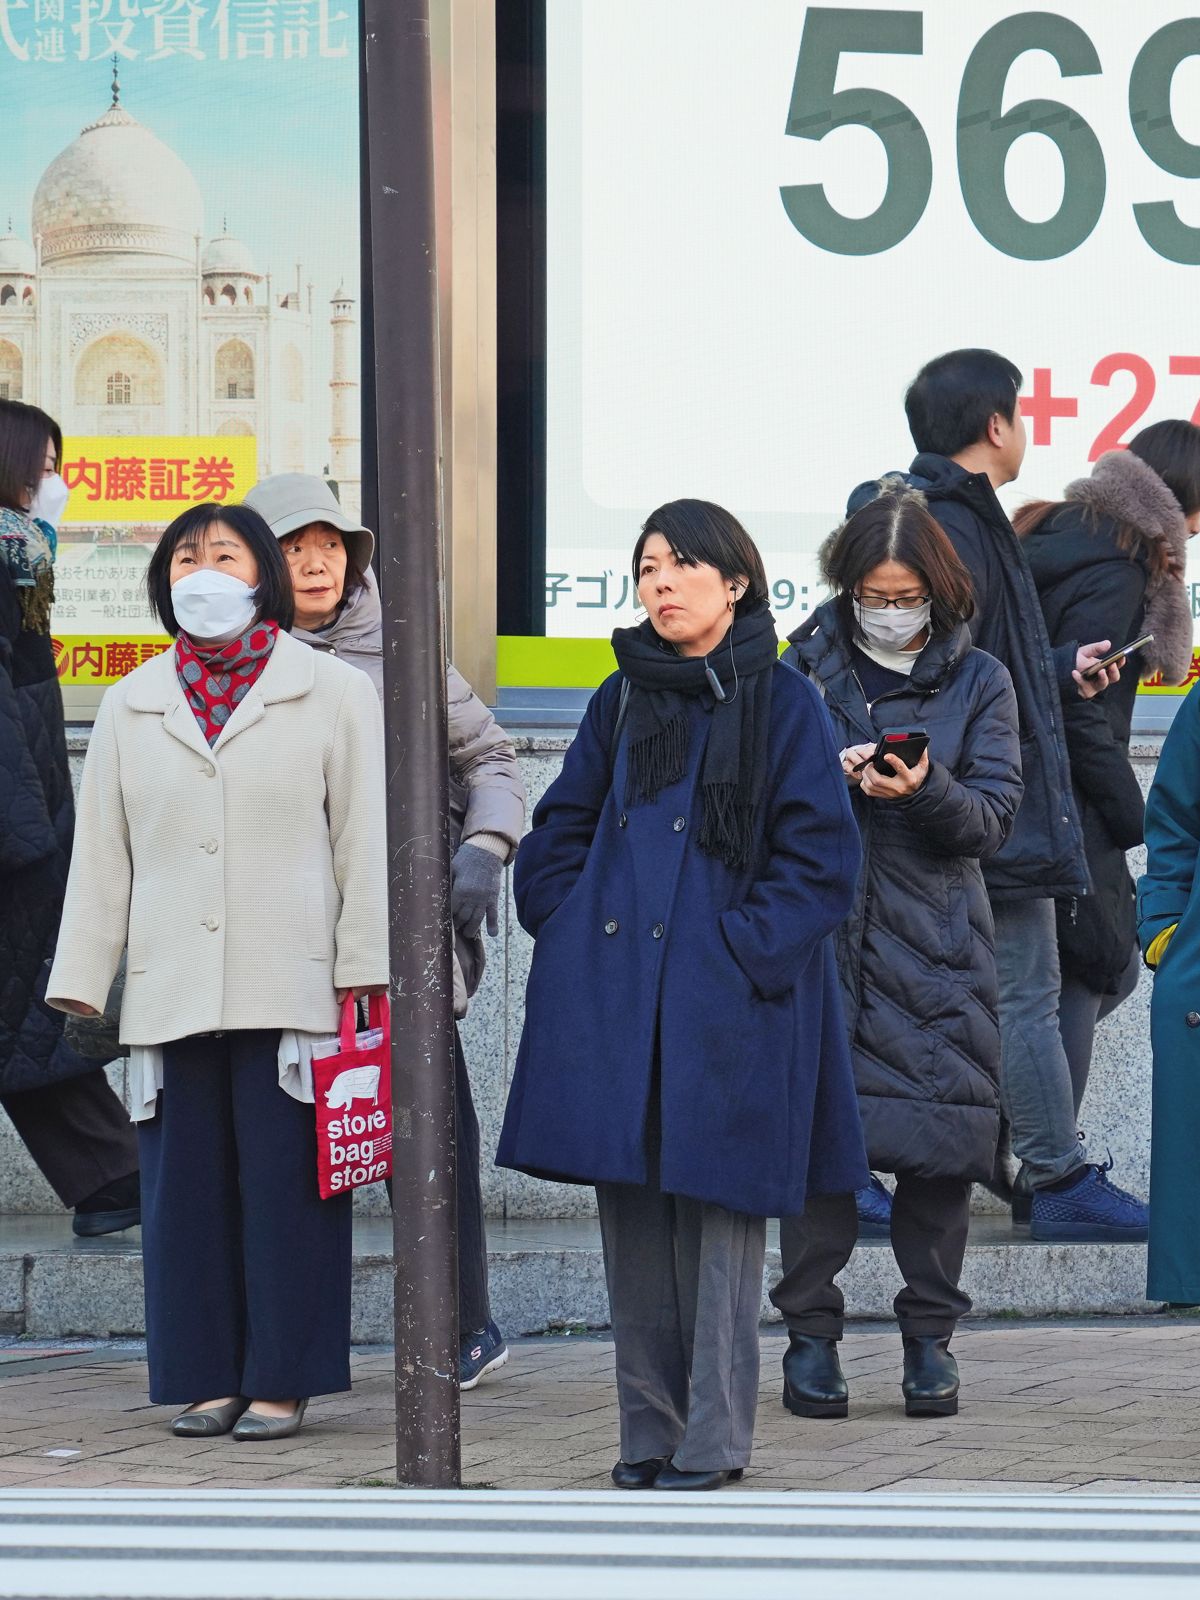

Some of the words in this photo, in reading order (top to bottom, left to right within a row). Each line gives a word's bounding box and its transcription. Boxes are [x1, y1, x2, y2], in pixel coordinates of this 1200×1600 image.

[63, 456, 235, 501] 内藤証券
[327, 1110, 387, 1140] store
[330, 1139, 375, 1166] bag
